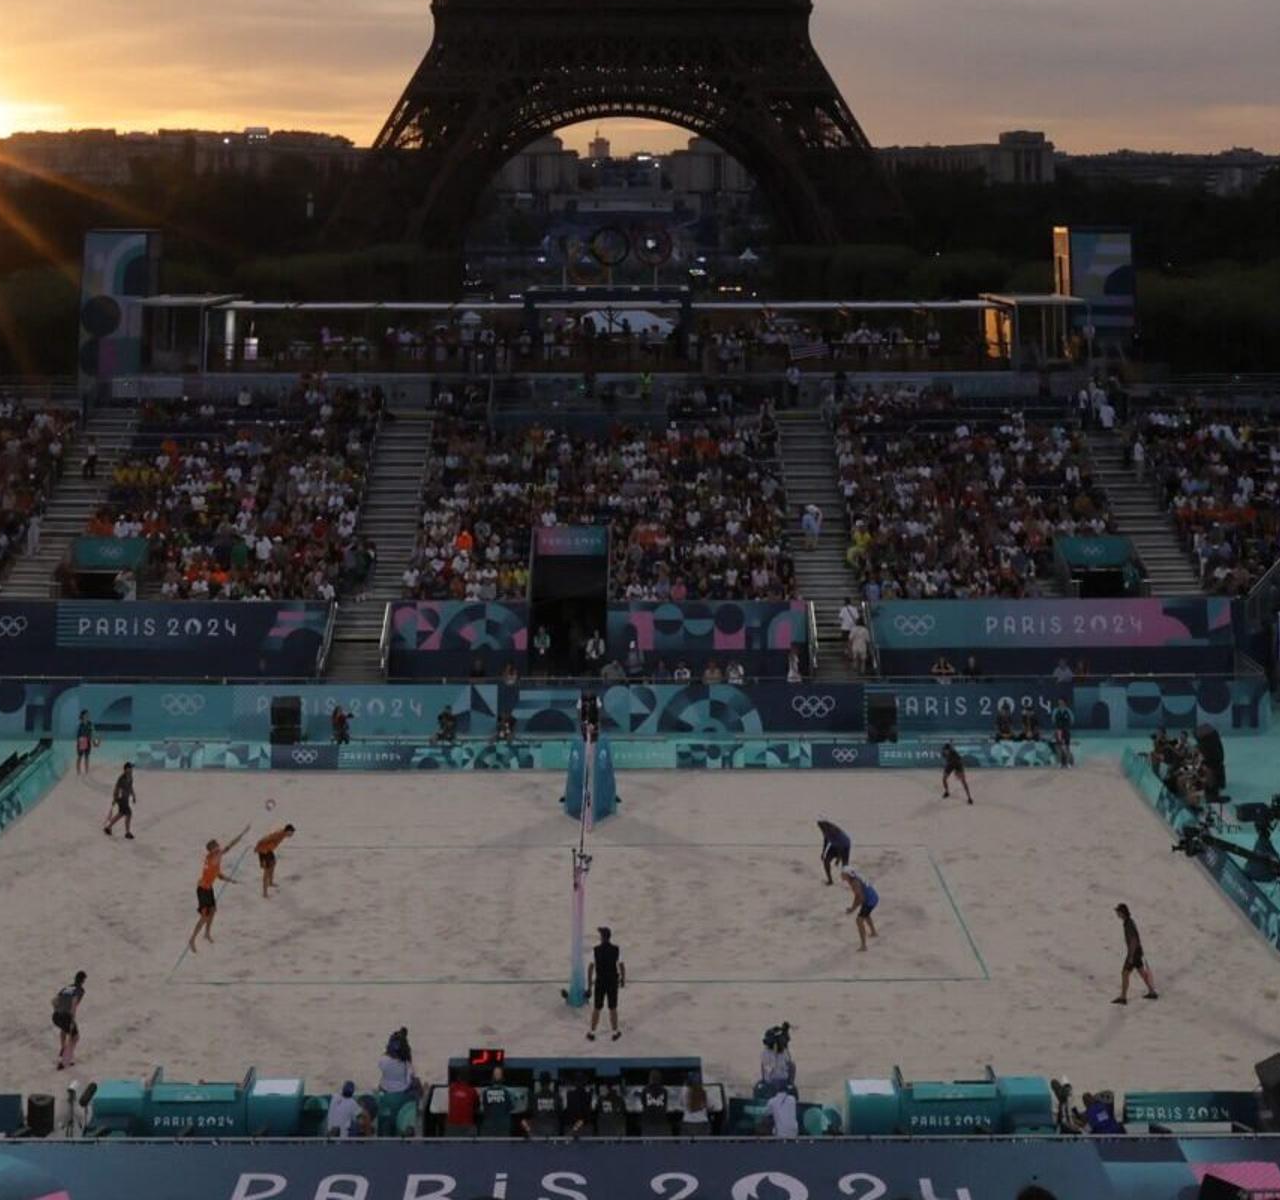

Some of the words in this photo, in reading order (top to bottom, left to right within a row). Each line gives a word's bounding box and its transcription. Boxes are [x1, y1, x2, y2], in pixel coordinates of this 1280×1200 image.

[167, 617, 237, 637] 2024
[1073, 615, 1143, 635] 2024
[348, 698, 422, 718] 2024
[895, 695, 967, 717] ARIS
[1186, 1106, 1230, 1120] 2024
